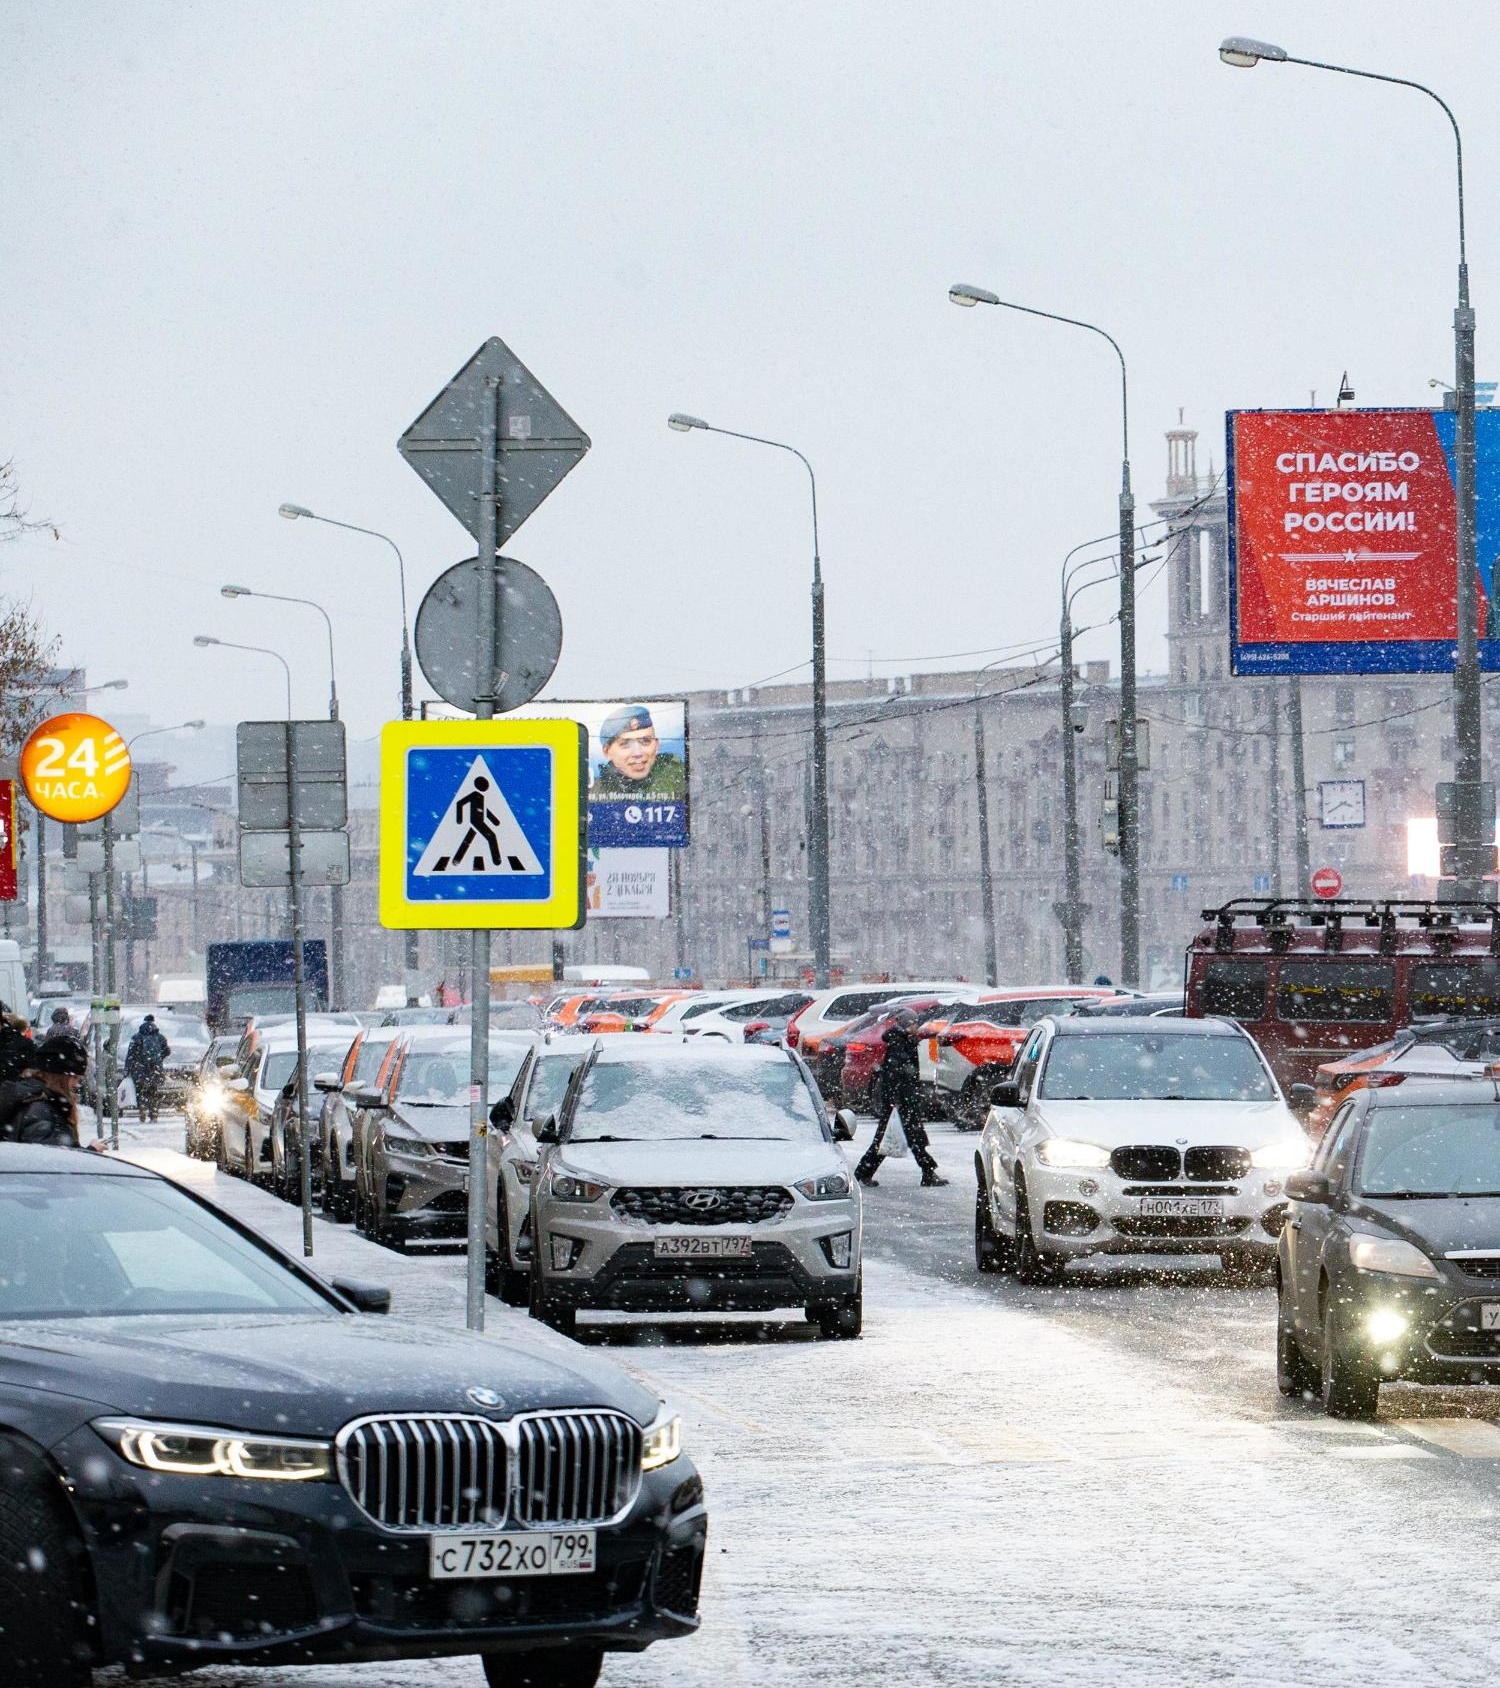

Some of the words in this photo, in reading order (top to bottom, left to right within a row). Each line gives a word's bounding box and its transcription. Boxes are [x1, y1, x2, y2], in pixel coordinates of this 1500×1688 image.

[1276, 451, 1420, 474] СПАСИБО
[1289, 481, 1408, 503] ГЕРОЯМ
[1284, 511, 1417, 533] РОССИИ!
[1305, 578, 1396, 592] ВЯЧЕСЛАВ
[1306, 593, 1396, 606] АРШИНОВ
[1291, 611, 1346, 623] Старший
[1348, 611, 1411, 622] лейтенант
[35, 737, 99, 778] 24
[35, 782, 98, 799] ЧАСА
[645, 806, 676, 823] 117
[660, 1238, 721, 1254] А392ВТ
[723, 1237, 747, 1249] 797
[441, 1538, 547, 1573] С732ХО
[553, 1534, 589, 1560] 799
[559, 1559, 579, 1569] RUS
